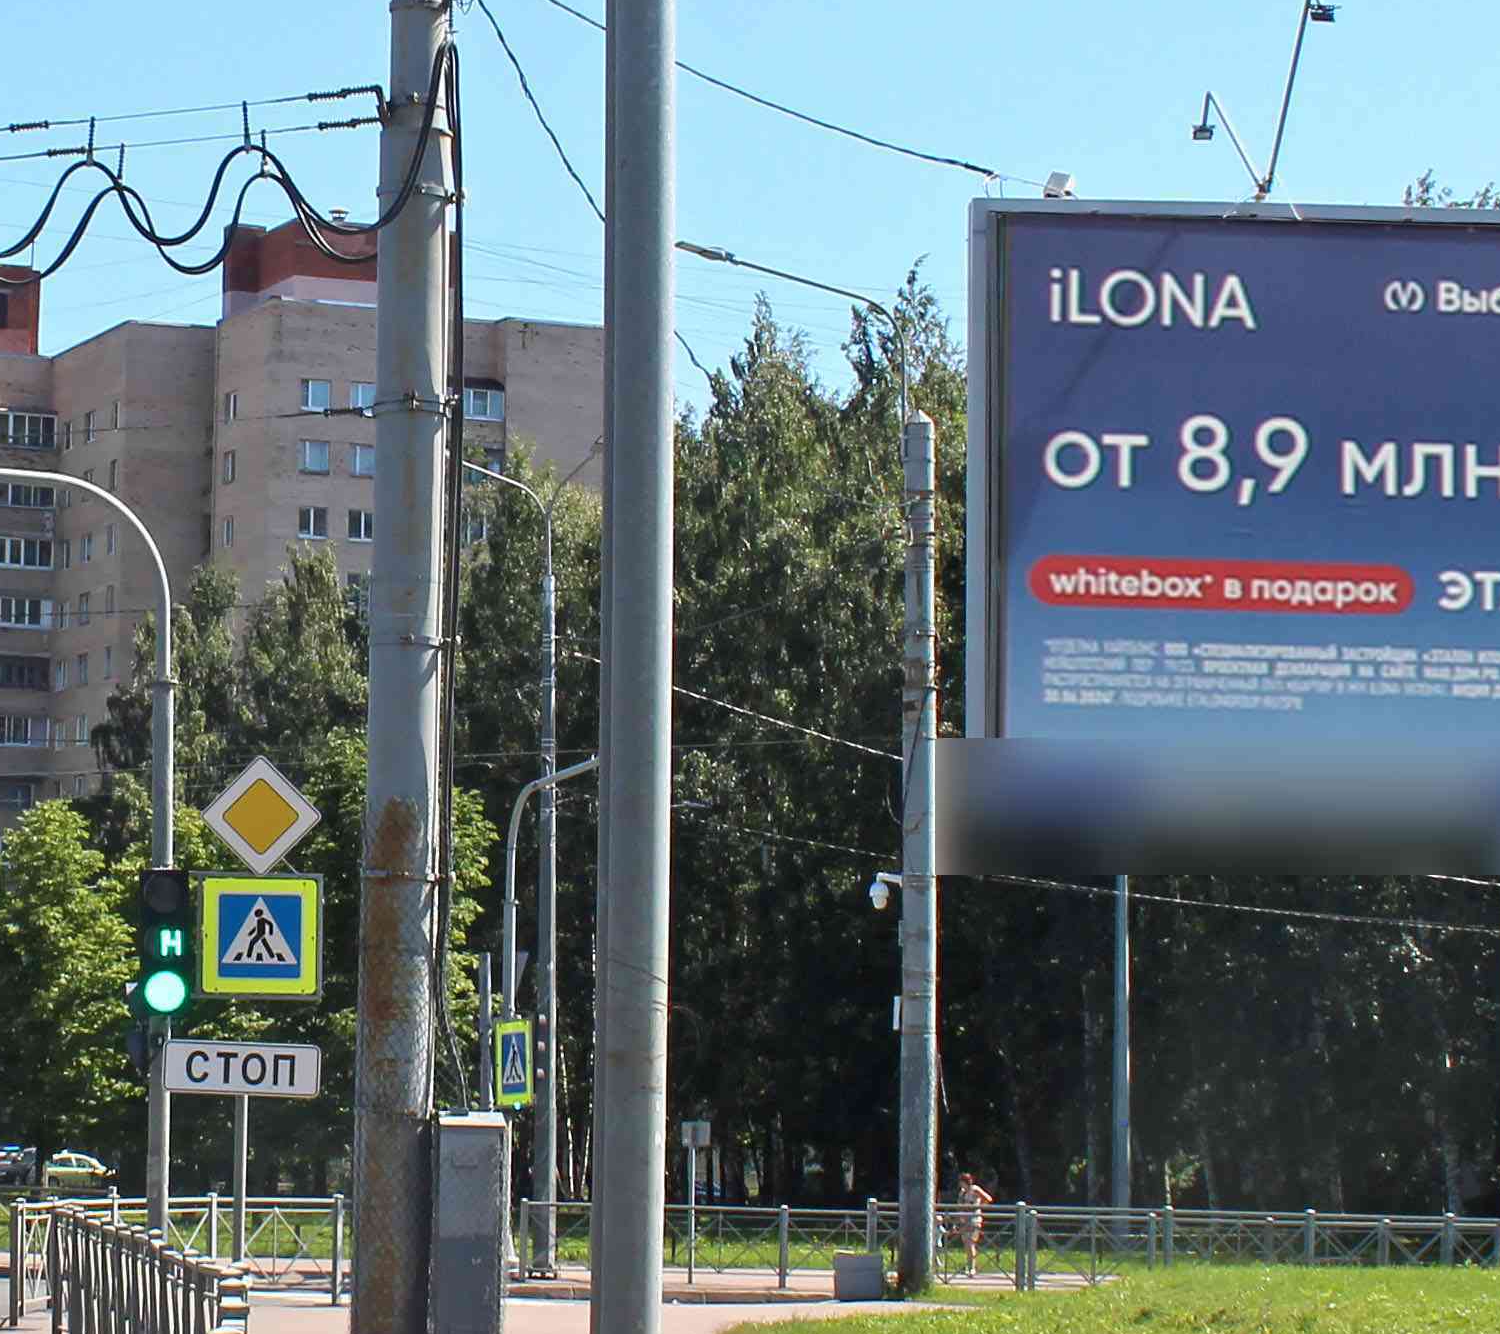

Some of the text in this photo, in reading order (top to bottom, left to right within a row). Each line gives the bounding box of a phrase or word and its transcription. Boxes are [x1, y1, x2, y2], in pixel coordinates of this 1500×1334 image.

[1049, 267, 1256, 330] iLONA
[1044, 430, 1150, 489] от
[1177, 414, 1308, 506] 8,9
[1222, 577, 1243, 600] в
[1250, 576, 1397, 610] подарок
[185, 1050, 297, 1087] СТОП
